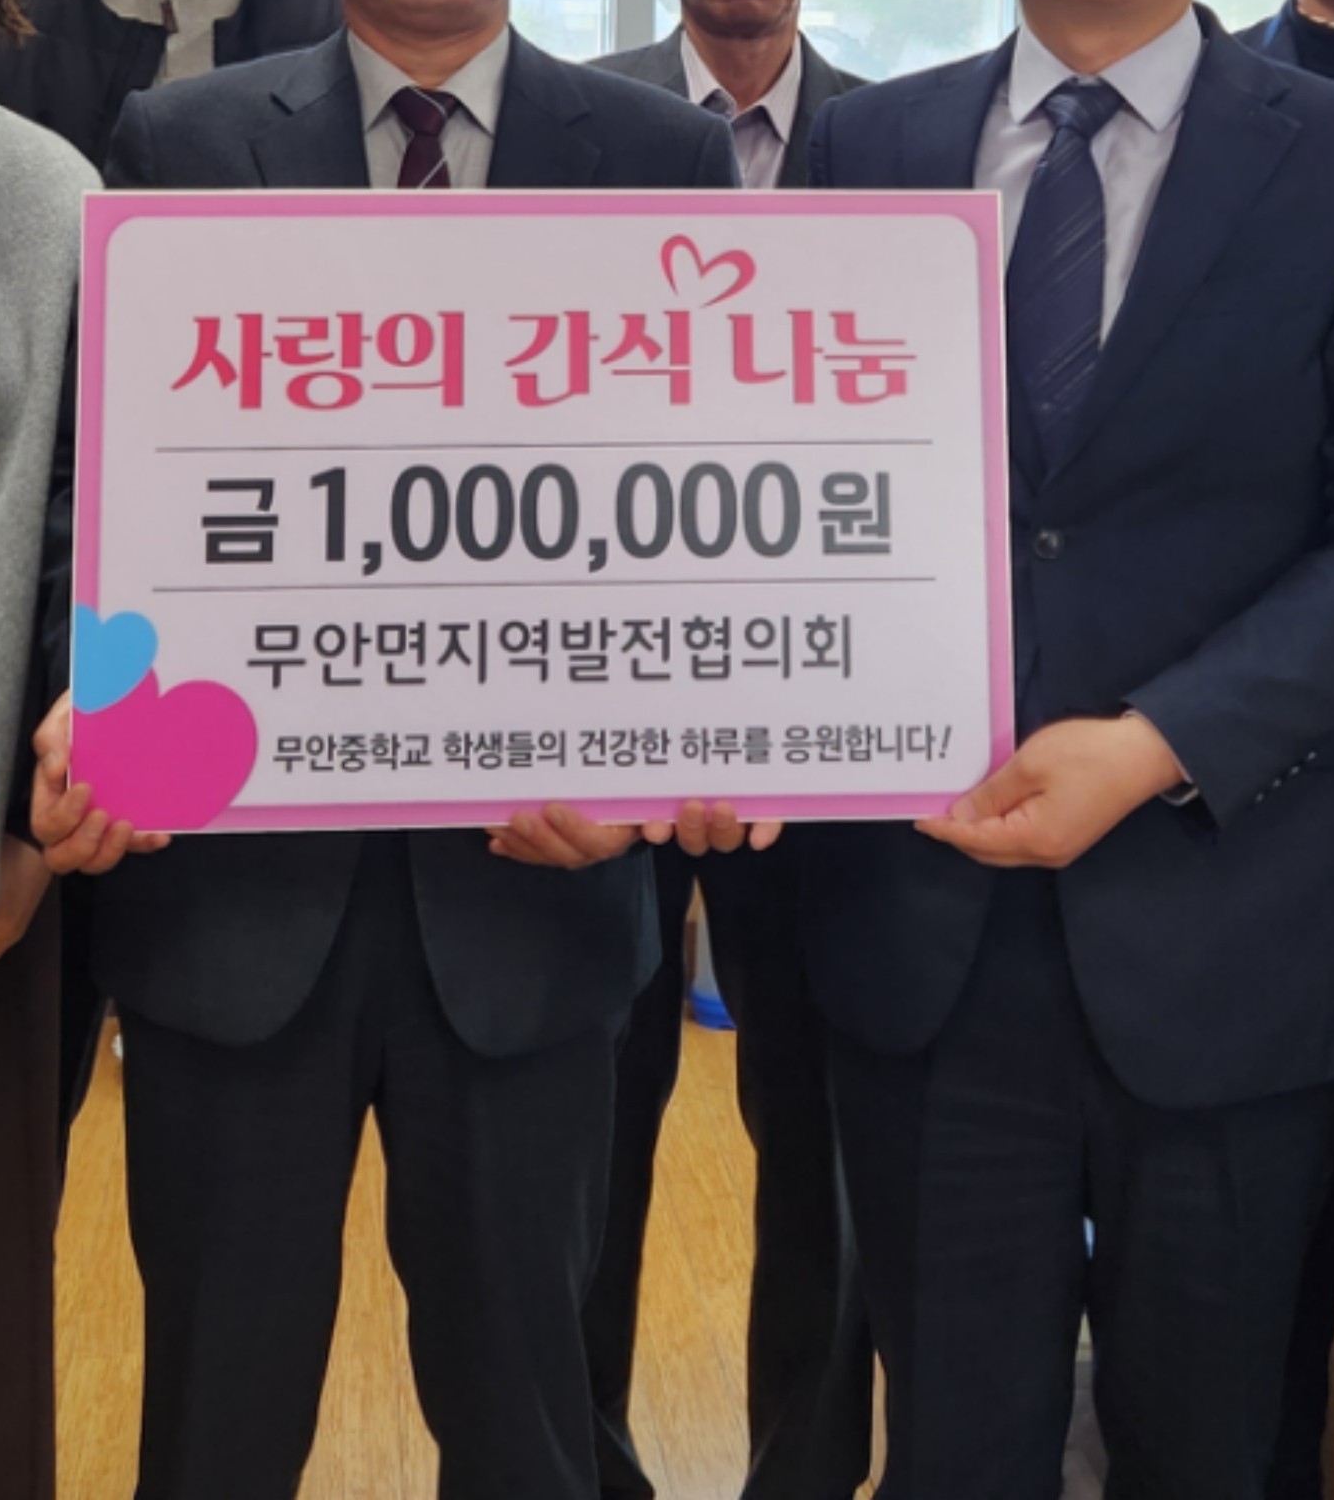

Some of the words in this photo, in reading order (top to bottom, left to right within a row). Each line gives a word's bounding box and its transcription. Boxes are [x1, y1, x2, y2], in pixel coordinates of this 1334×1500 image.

[172, 311, 464, 410] 사랑의
[506, 311, 691, 407] 간식
[731, 310, 916, 404] 나눔
[245, 614, 852, 688] 무안면지역발전협의회
[272, 732, 433, 773] 무안중학교
[442, 729, 566, 770] 학생들의
[578, 727, 671, 767] 건강한
[680, 726, 773, 765] 하루를
[782, 723, 954, 765] 응원합니다!
